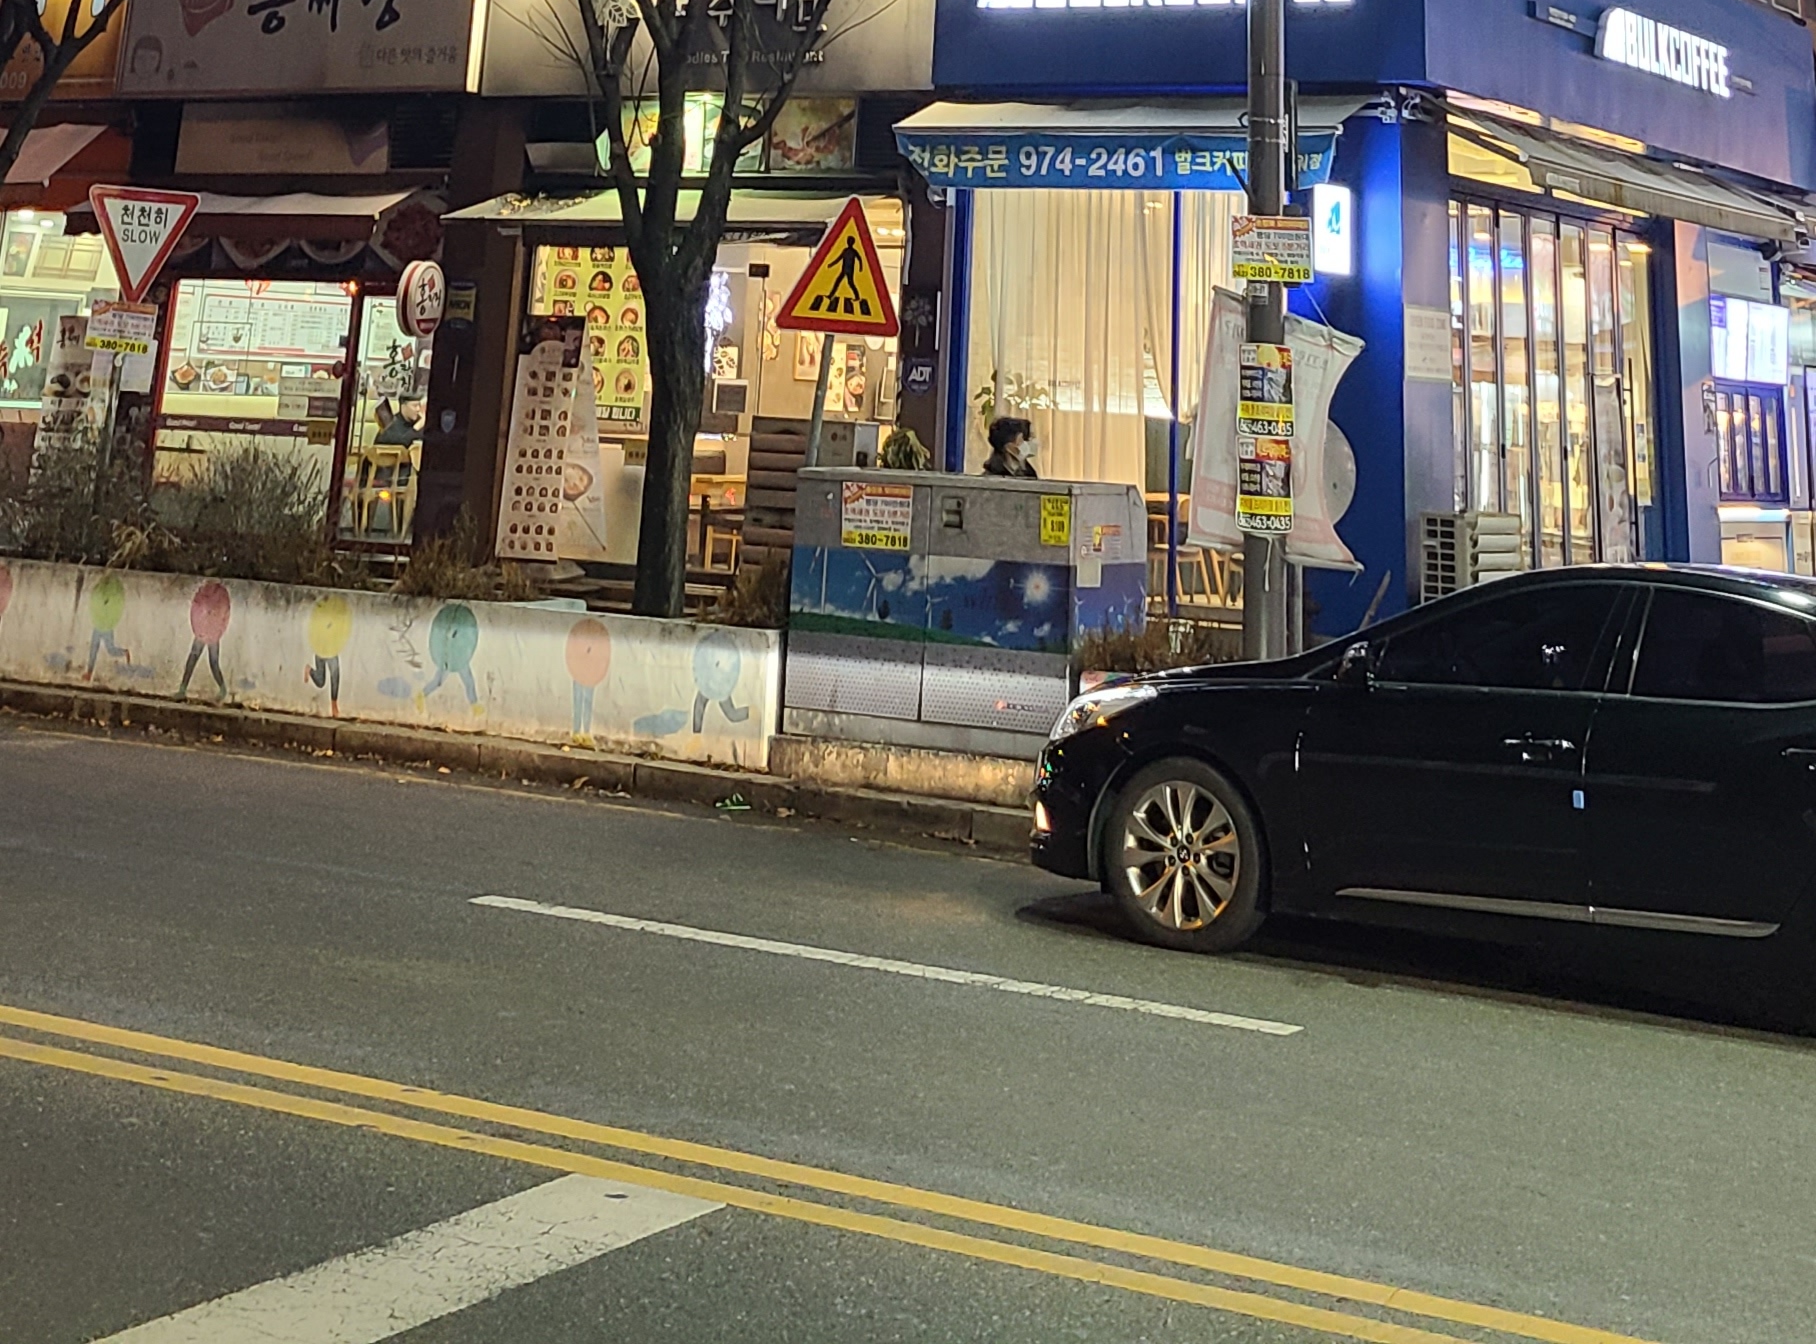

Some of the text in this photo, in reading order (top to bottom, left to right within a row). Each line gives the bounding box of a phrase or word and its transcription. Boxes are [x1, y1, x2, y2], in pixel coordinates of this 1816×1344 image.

[1625, 9, 1732, 99] BULKCOFFEE
[908, 143, 1010, 180] 전화주문
[1018, 144, 1164, 179] 974-2461
[120, 204, 169, 230] 천천히
[121, 228, 162, 246] SLOW
[1249, 265, 1311, 280] 380-7818
[99, 339, 149, 354] 380-7818
[908, 366, 933, 383] ADT
[1250, 514, 1292, 530] 463-0435
